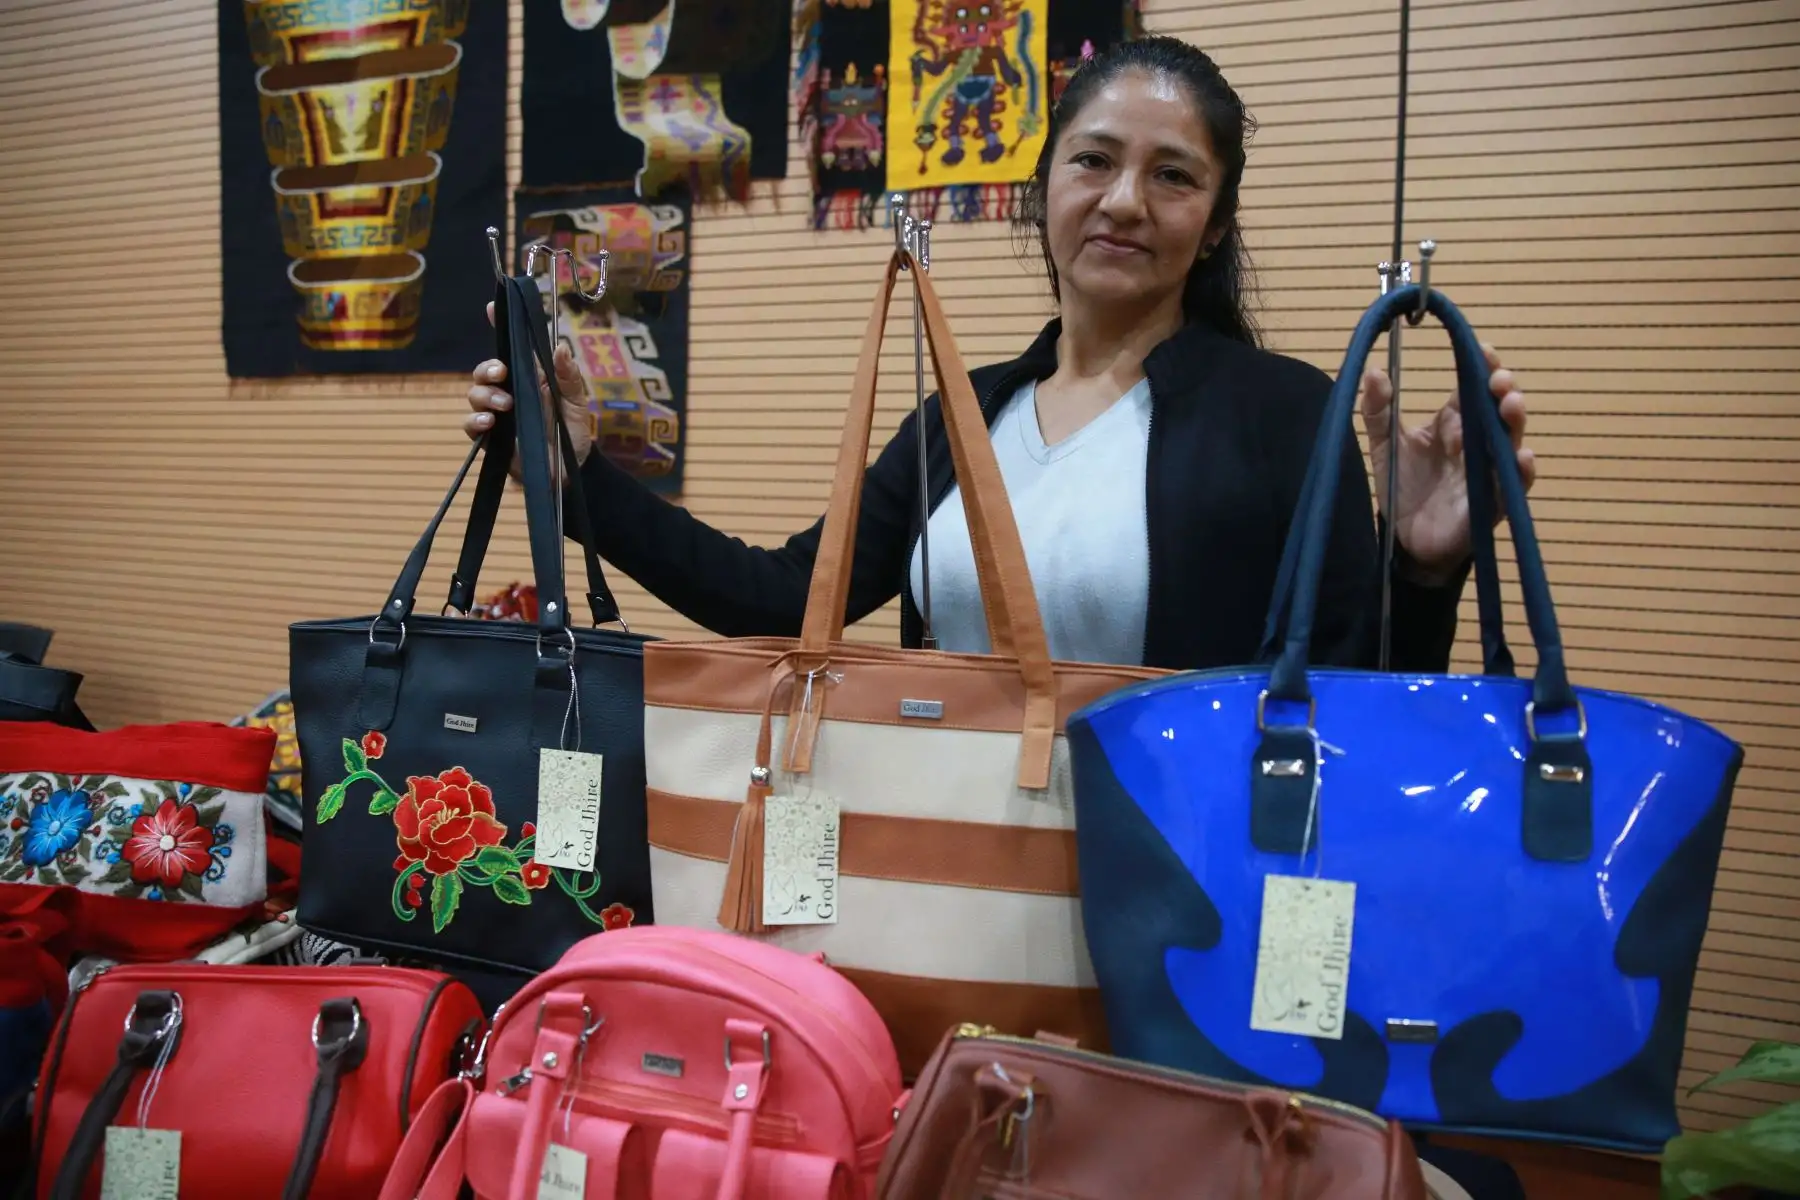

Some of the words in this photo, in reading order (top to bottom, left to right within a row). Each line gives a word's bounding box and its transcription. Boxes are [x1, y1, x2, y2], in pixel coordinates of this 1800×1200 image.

[446, 717, 460, 726] God
[903, 703, 920, 713] God
[581, 779, 598, 823] Jhire
[576, 829, 595, 867] God
[817, 823, 836, 871] Jhire
[816, 878, 834, 919] God
[1323, 915, 1349, 975] Jhire
[1317, 982, 1341, 1032] God
[155, 1160, 177, 1200] hire
